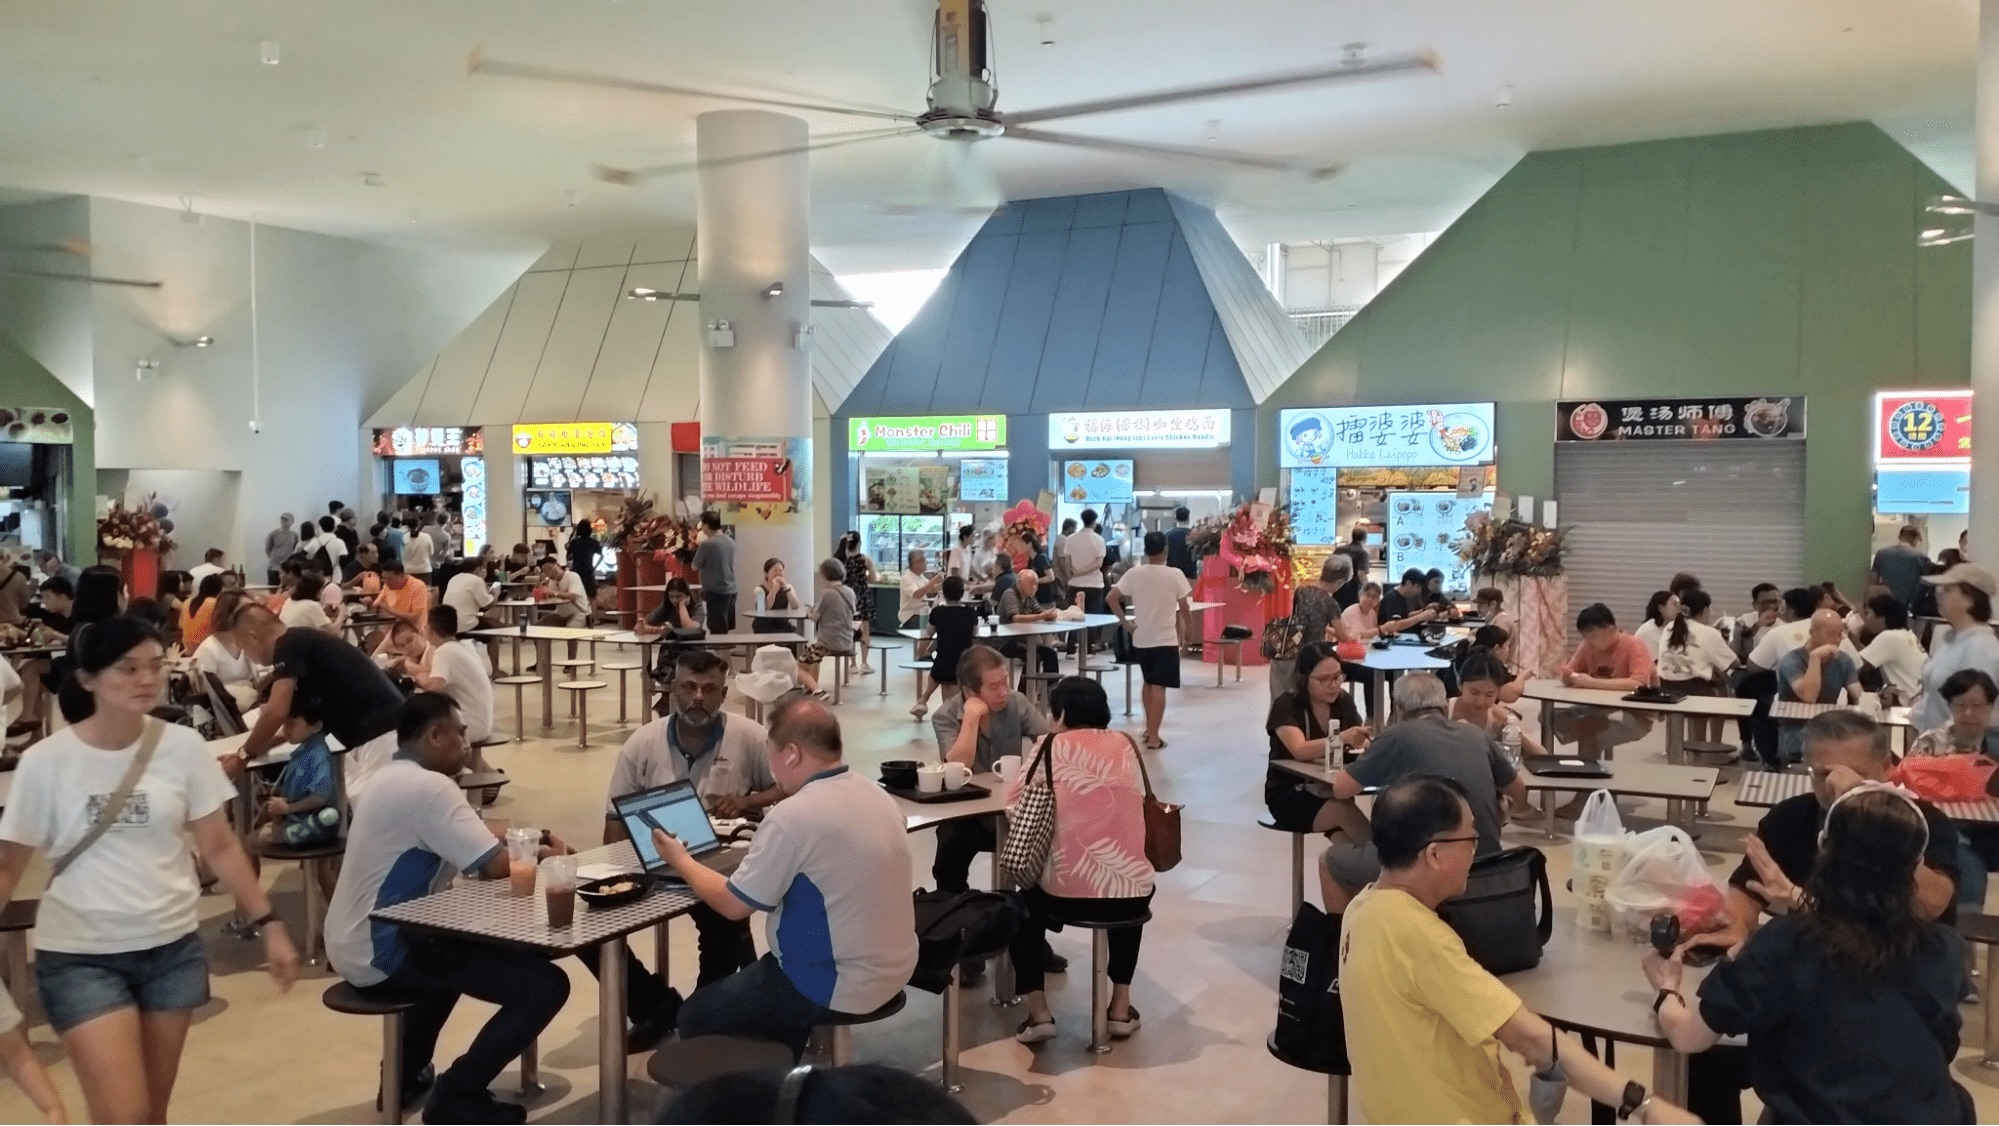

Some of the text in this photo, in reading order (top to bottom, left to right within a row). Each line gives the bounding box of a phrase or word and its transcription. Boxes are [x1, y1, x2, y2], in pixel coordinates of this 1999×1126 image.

[1621, 403, 1734, 422] 煲汤师傅
[1336, 409, 1430, 446] 擂婆婆
[1903, 411, 1933, 432] 12
[874, 425, 935, 437] Monster
[938, 424, 972, 437] Chili
[1618, 423, 1736, 436] MASTER TANG
[1346, 448, 1418, 462] Hakka Leipopo
[712, 462, 731, 471] NOT
[735, 462, 768, 471] FEED
[715, 472, 764, 481] DISTURB
[714, 481, 772, 492] WILDLIFE
[1396, 516, 1404, 526] A
[1397, 552, 1405, 562] B
